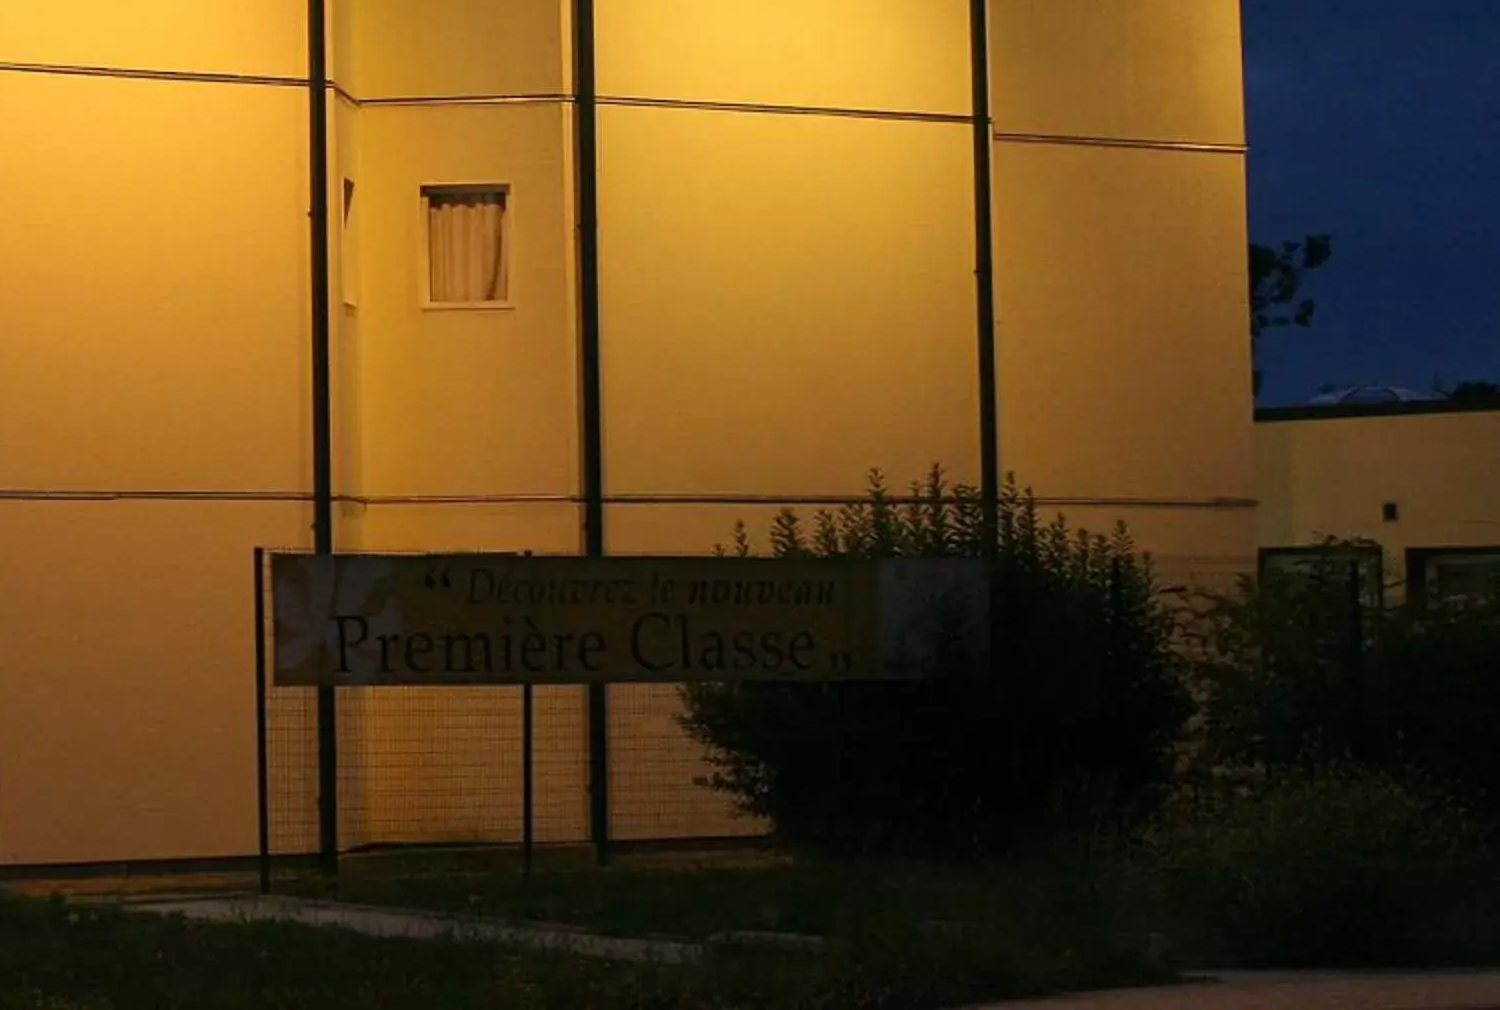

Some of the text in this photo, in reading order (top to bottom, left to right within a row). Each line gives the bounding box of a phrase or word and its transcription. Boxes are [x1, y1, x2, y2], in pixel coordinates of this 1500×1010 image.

[649, 568, 677, 606] le
[687, 576, 836, 607] nouveau
[329, 613, 607, 673] Première
